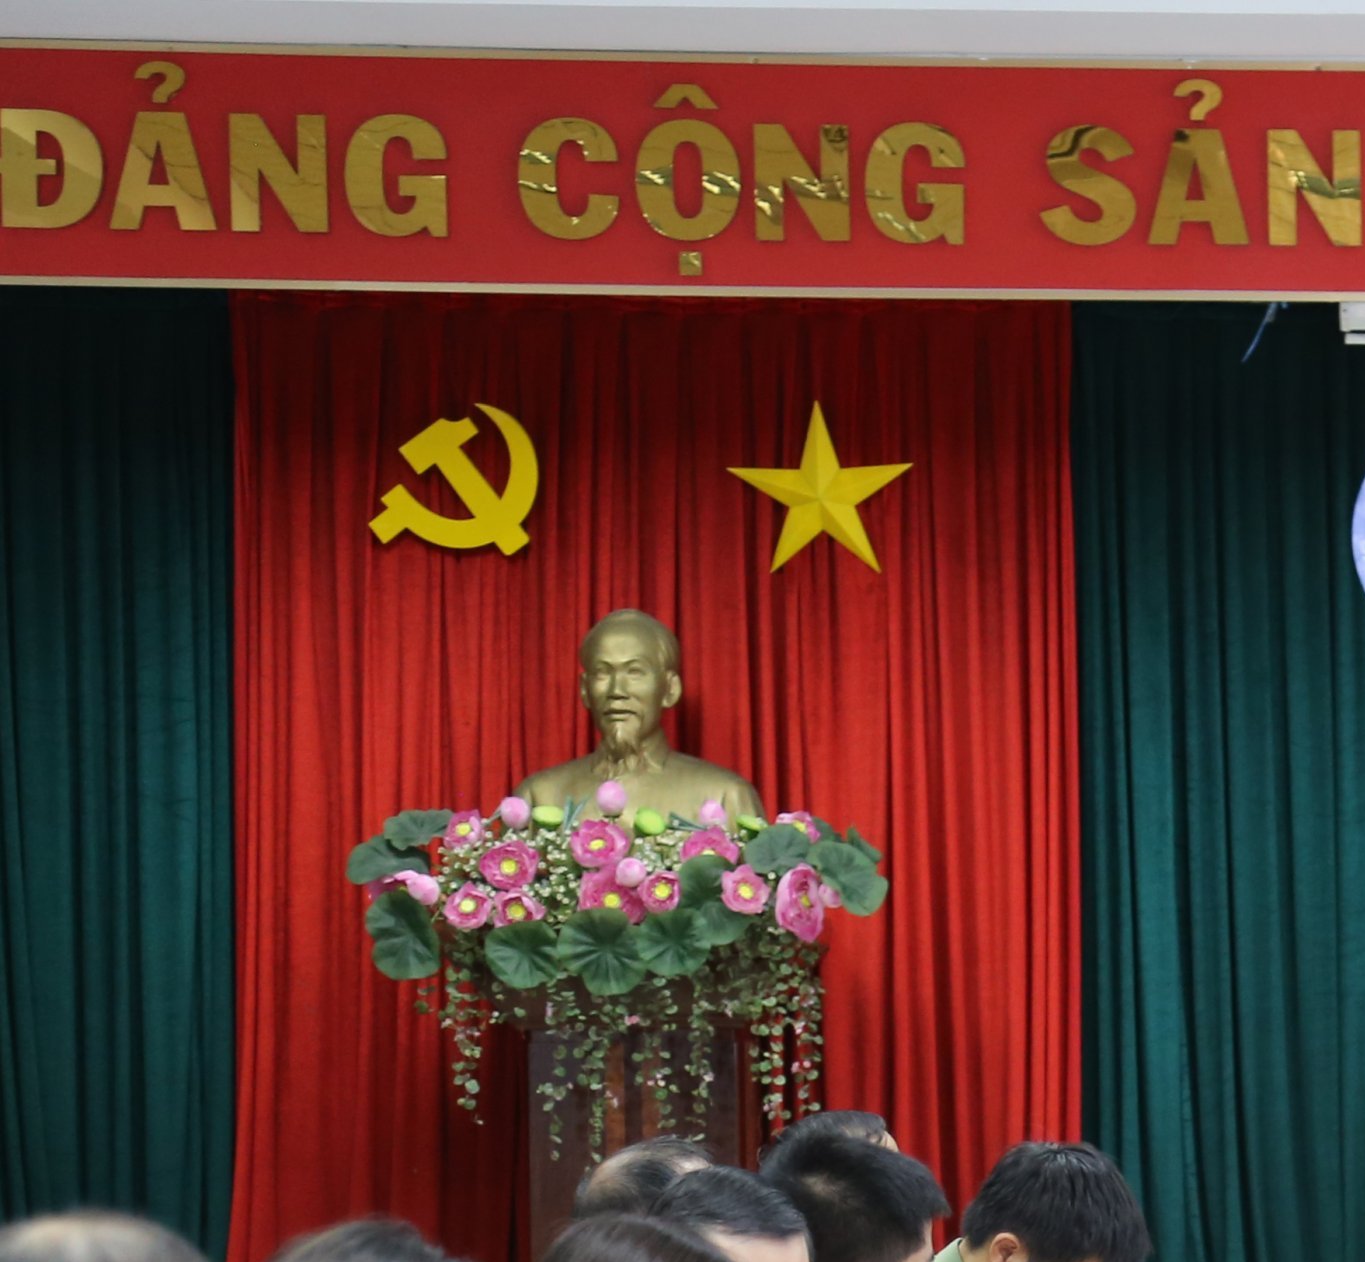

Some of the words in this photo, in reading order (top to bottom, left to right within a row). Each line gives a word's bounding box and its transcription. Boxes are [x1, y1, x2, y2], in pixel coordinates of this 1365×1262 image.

[0, 60, 449, 237] ĐẢNG
[518, 83, 966, 276] CỘNG
[1040, 79, 1364, 248] SẢN
